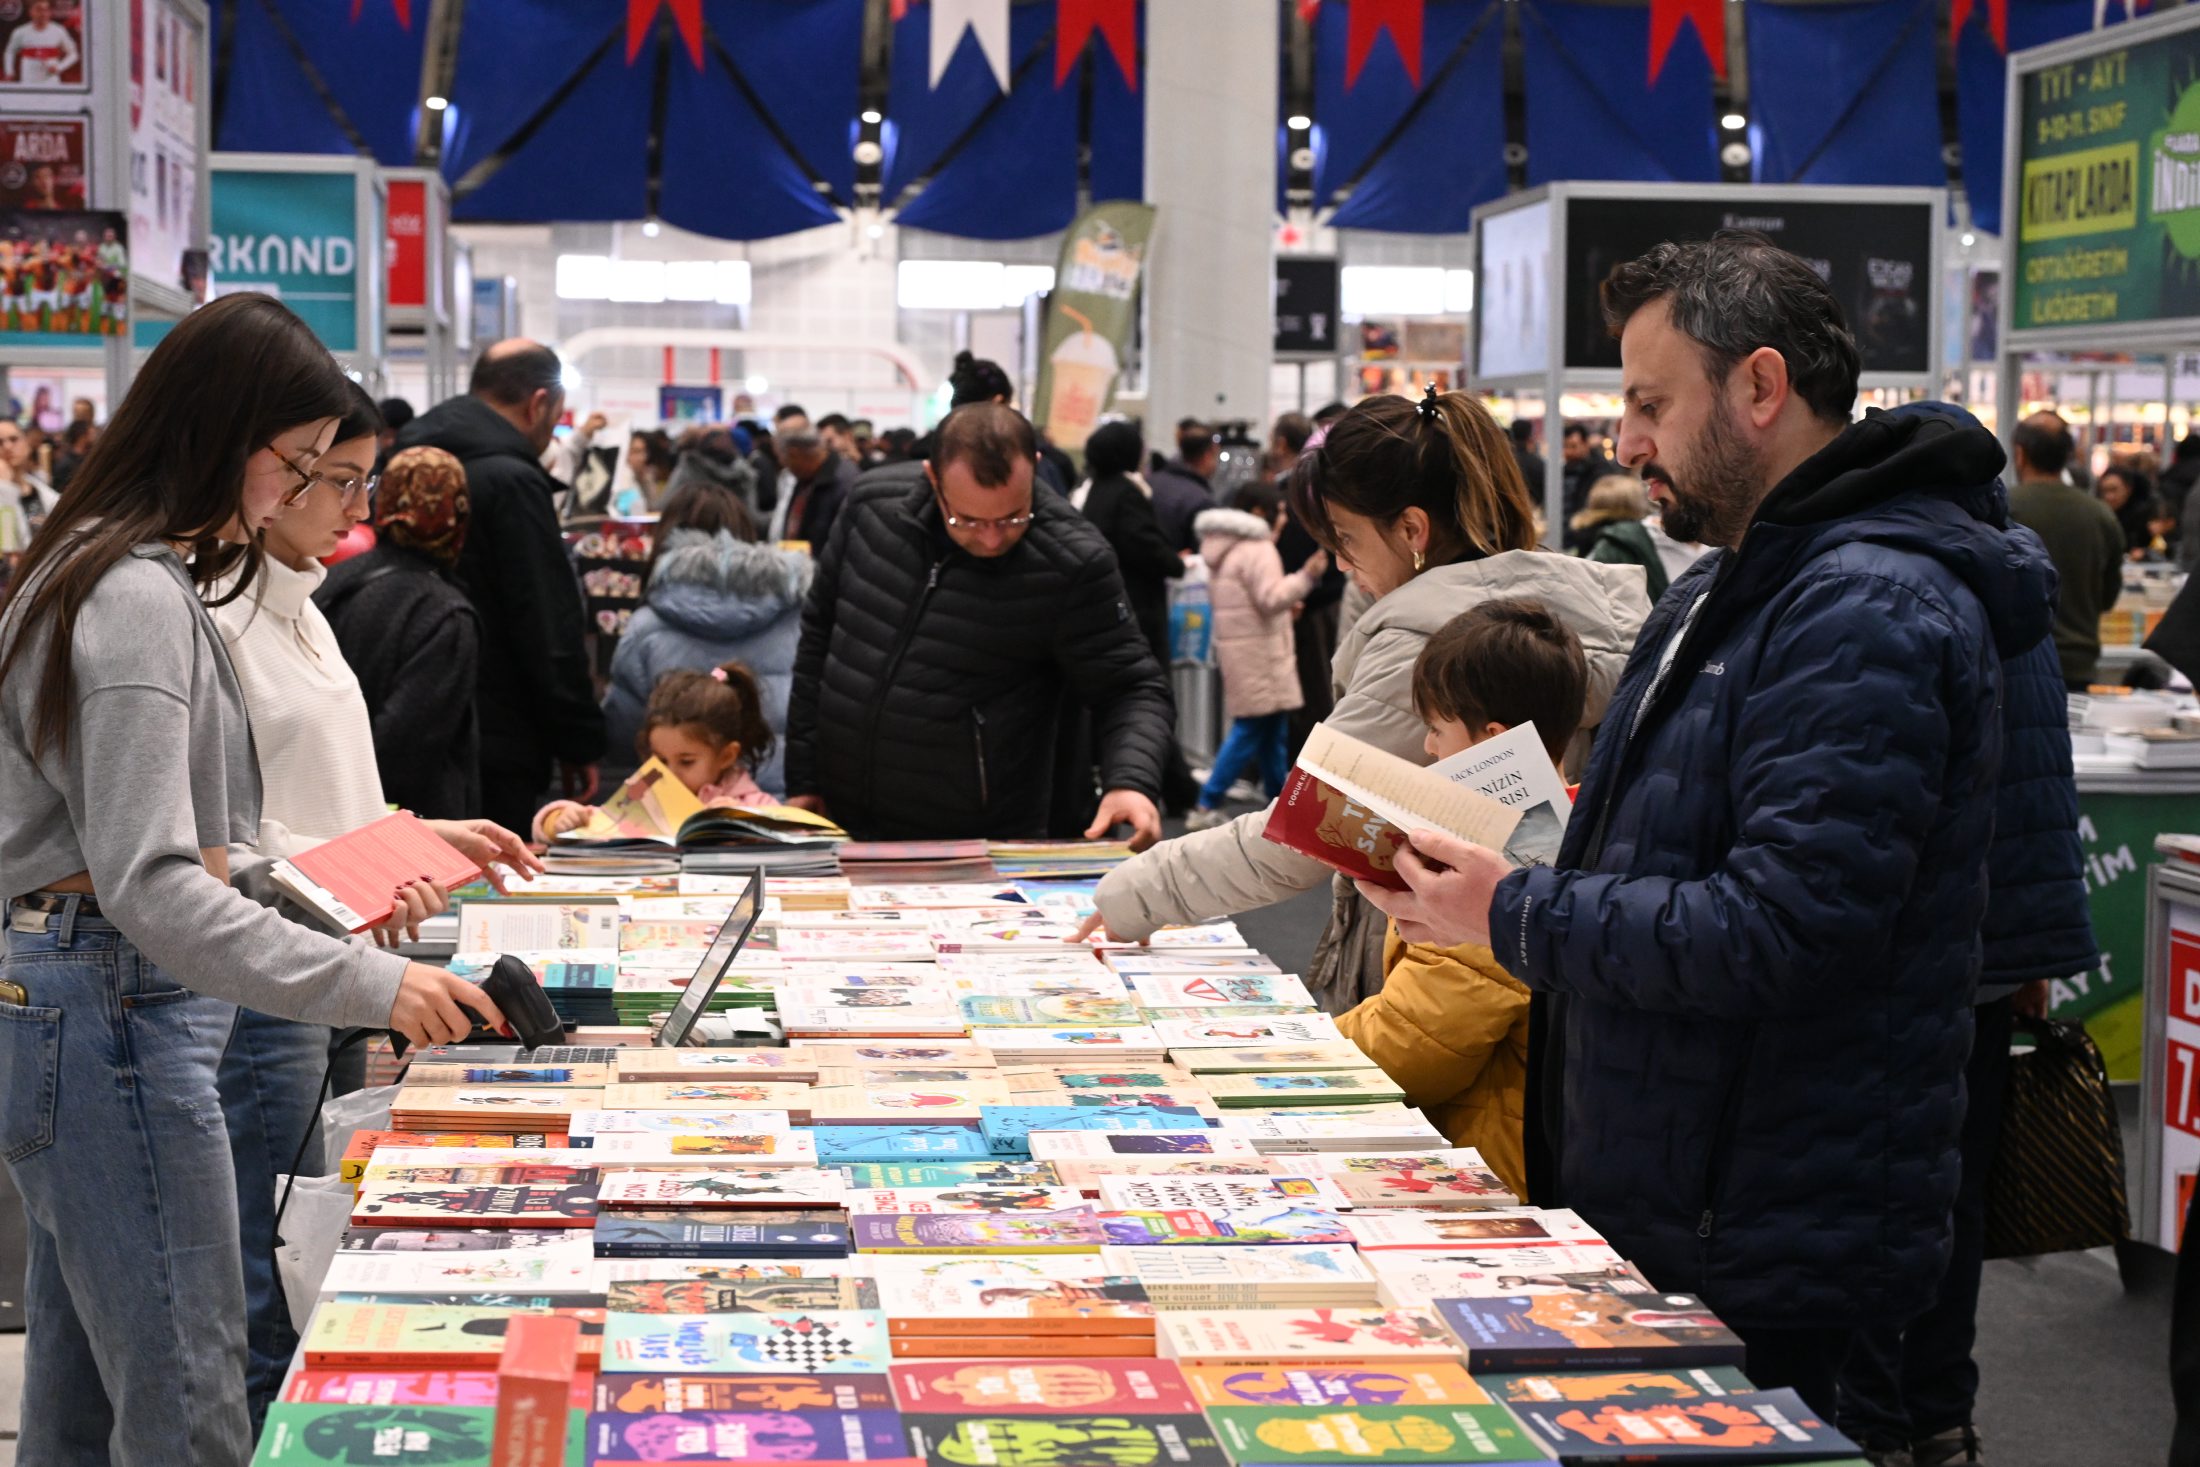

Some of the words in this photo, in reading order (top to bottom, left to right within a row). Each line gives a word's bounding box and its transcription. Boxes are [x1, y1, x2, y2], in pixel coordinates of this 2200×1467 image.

[13, 134, 69, 161] ARDA
[1474, 748, 1516, 773] LONDON
[1520, 895, 1533, 967] OMNI-HEAT
[623, 1184, 649, 1199] DON
[1128, 1182, 1163, 1208] KÜÇÜK
[1163, 1186, 1196, 1208] ADAM
[1191, 1182, 1228, 1208] KÜÇÜK
